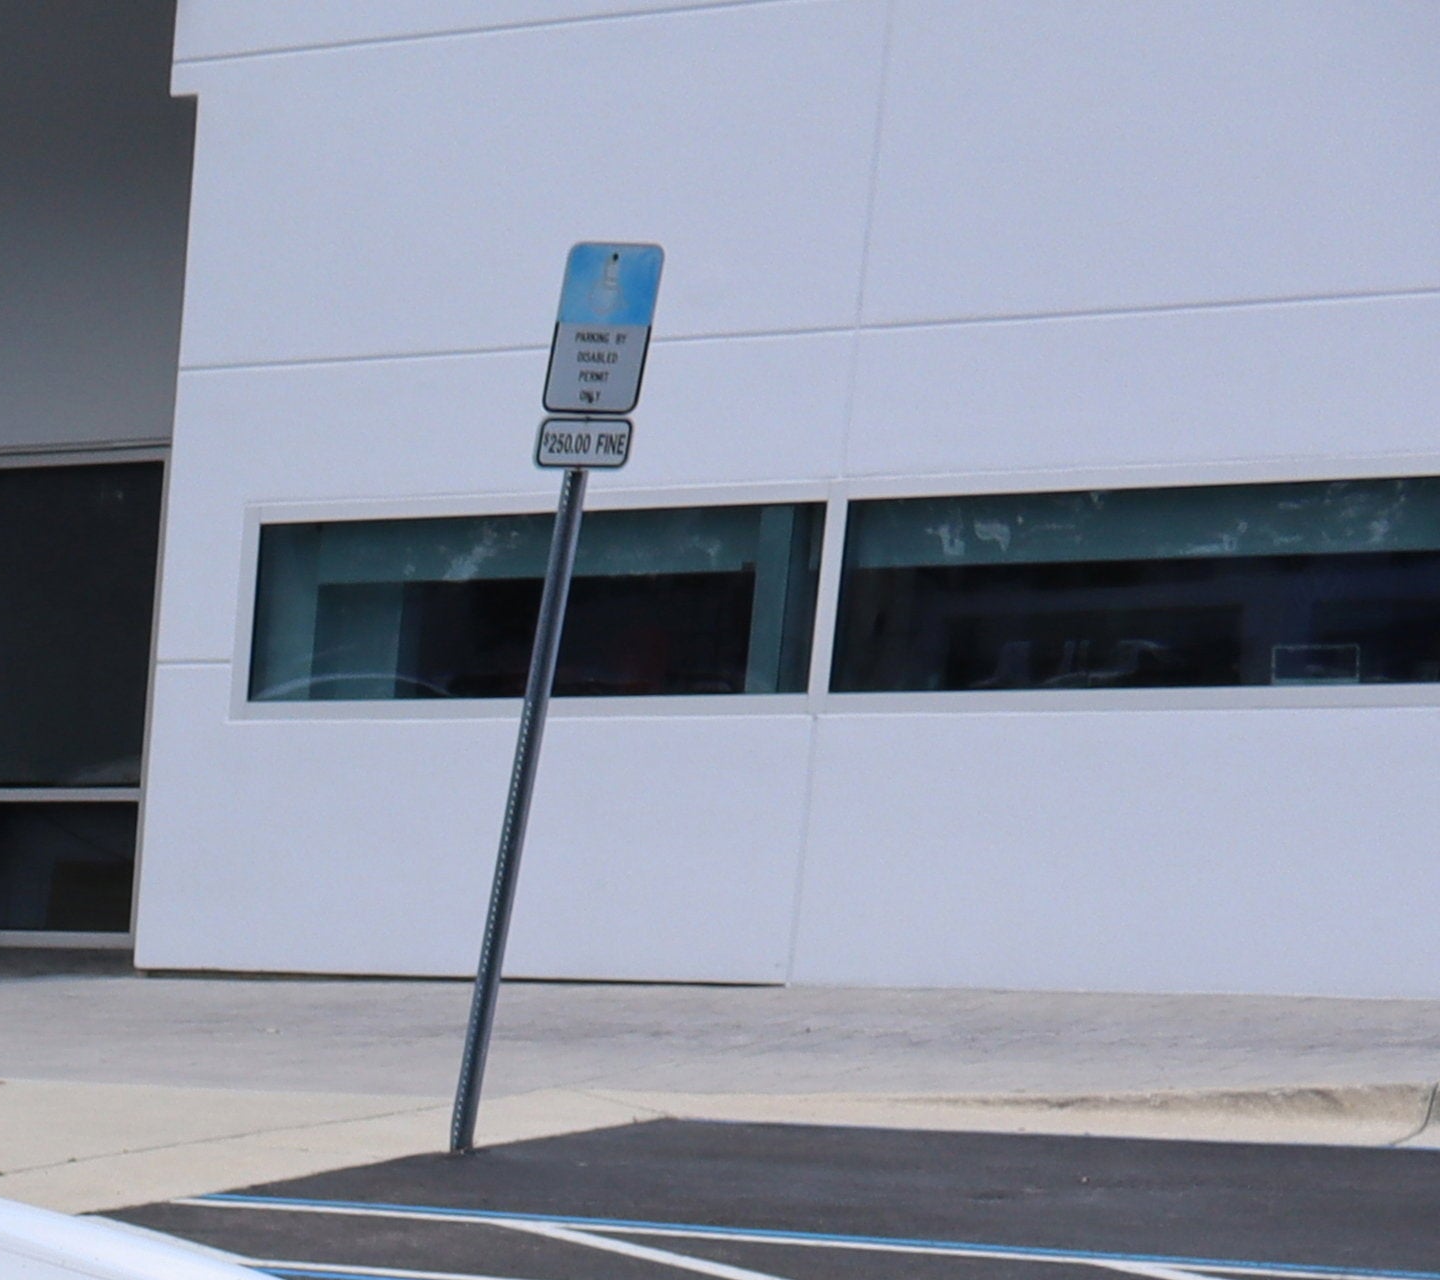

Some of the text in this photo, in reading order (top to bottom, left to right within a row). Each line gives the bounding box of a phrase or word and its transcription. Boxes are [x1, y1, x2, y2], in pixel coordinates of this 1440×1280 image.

[575, 331, 627, 344] PARKING BY
[577, 352, 619, 364] DISABLED
[578, 371, 609, 382] PERMIT
[544, 432, 626, 455] $250.00 FINE
